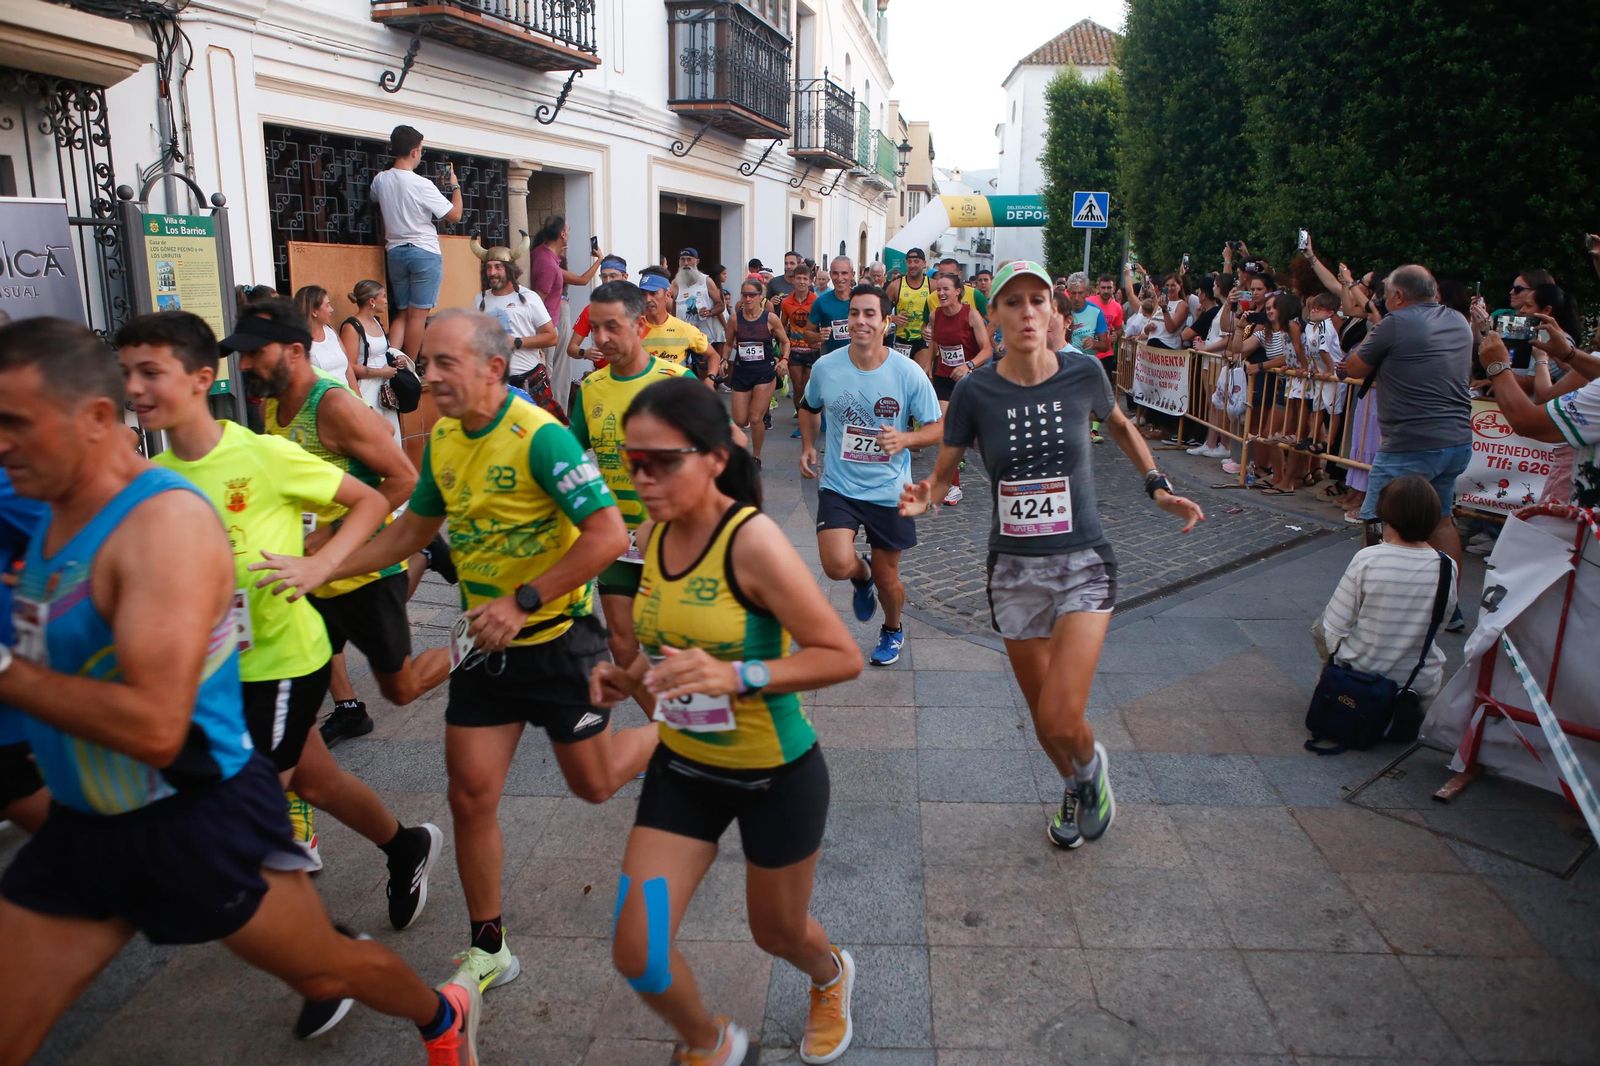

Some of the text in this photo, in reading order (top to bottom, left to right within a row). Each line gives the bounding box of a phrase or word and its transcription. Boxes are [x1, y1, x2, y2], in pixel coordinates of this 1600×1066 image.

[166, 226, 206, 235] Los Barrios
[1007, 401, 1062, 419] NIKE
[1472, 442, 1554, 463] ONTENEDORE
[1518, 460, 1550, 476] 626
[1010, 497, 1054, 520] 424
